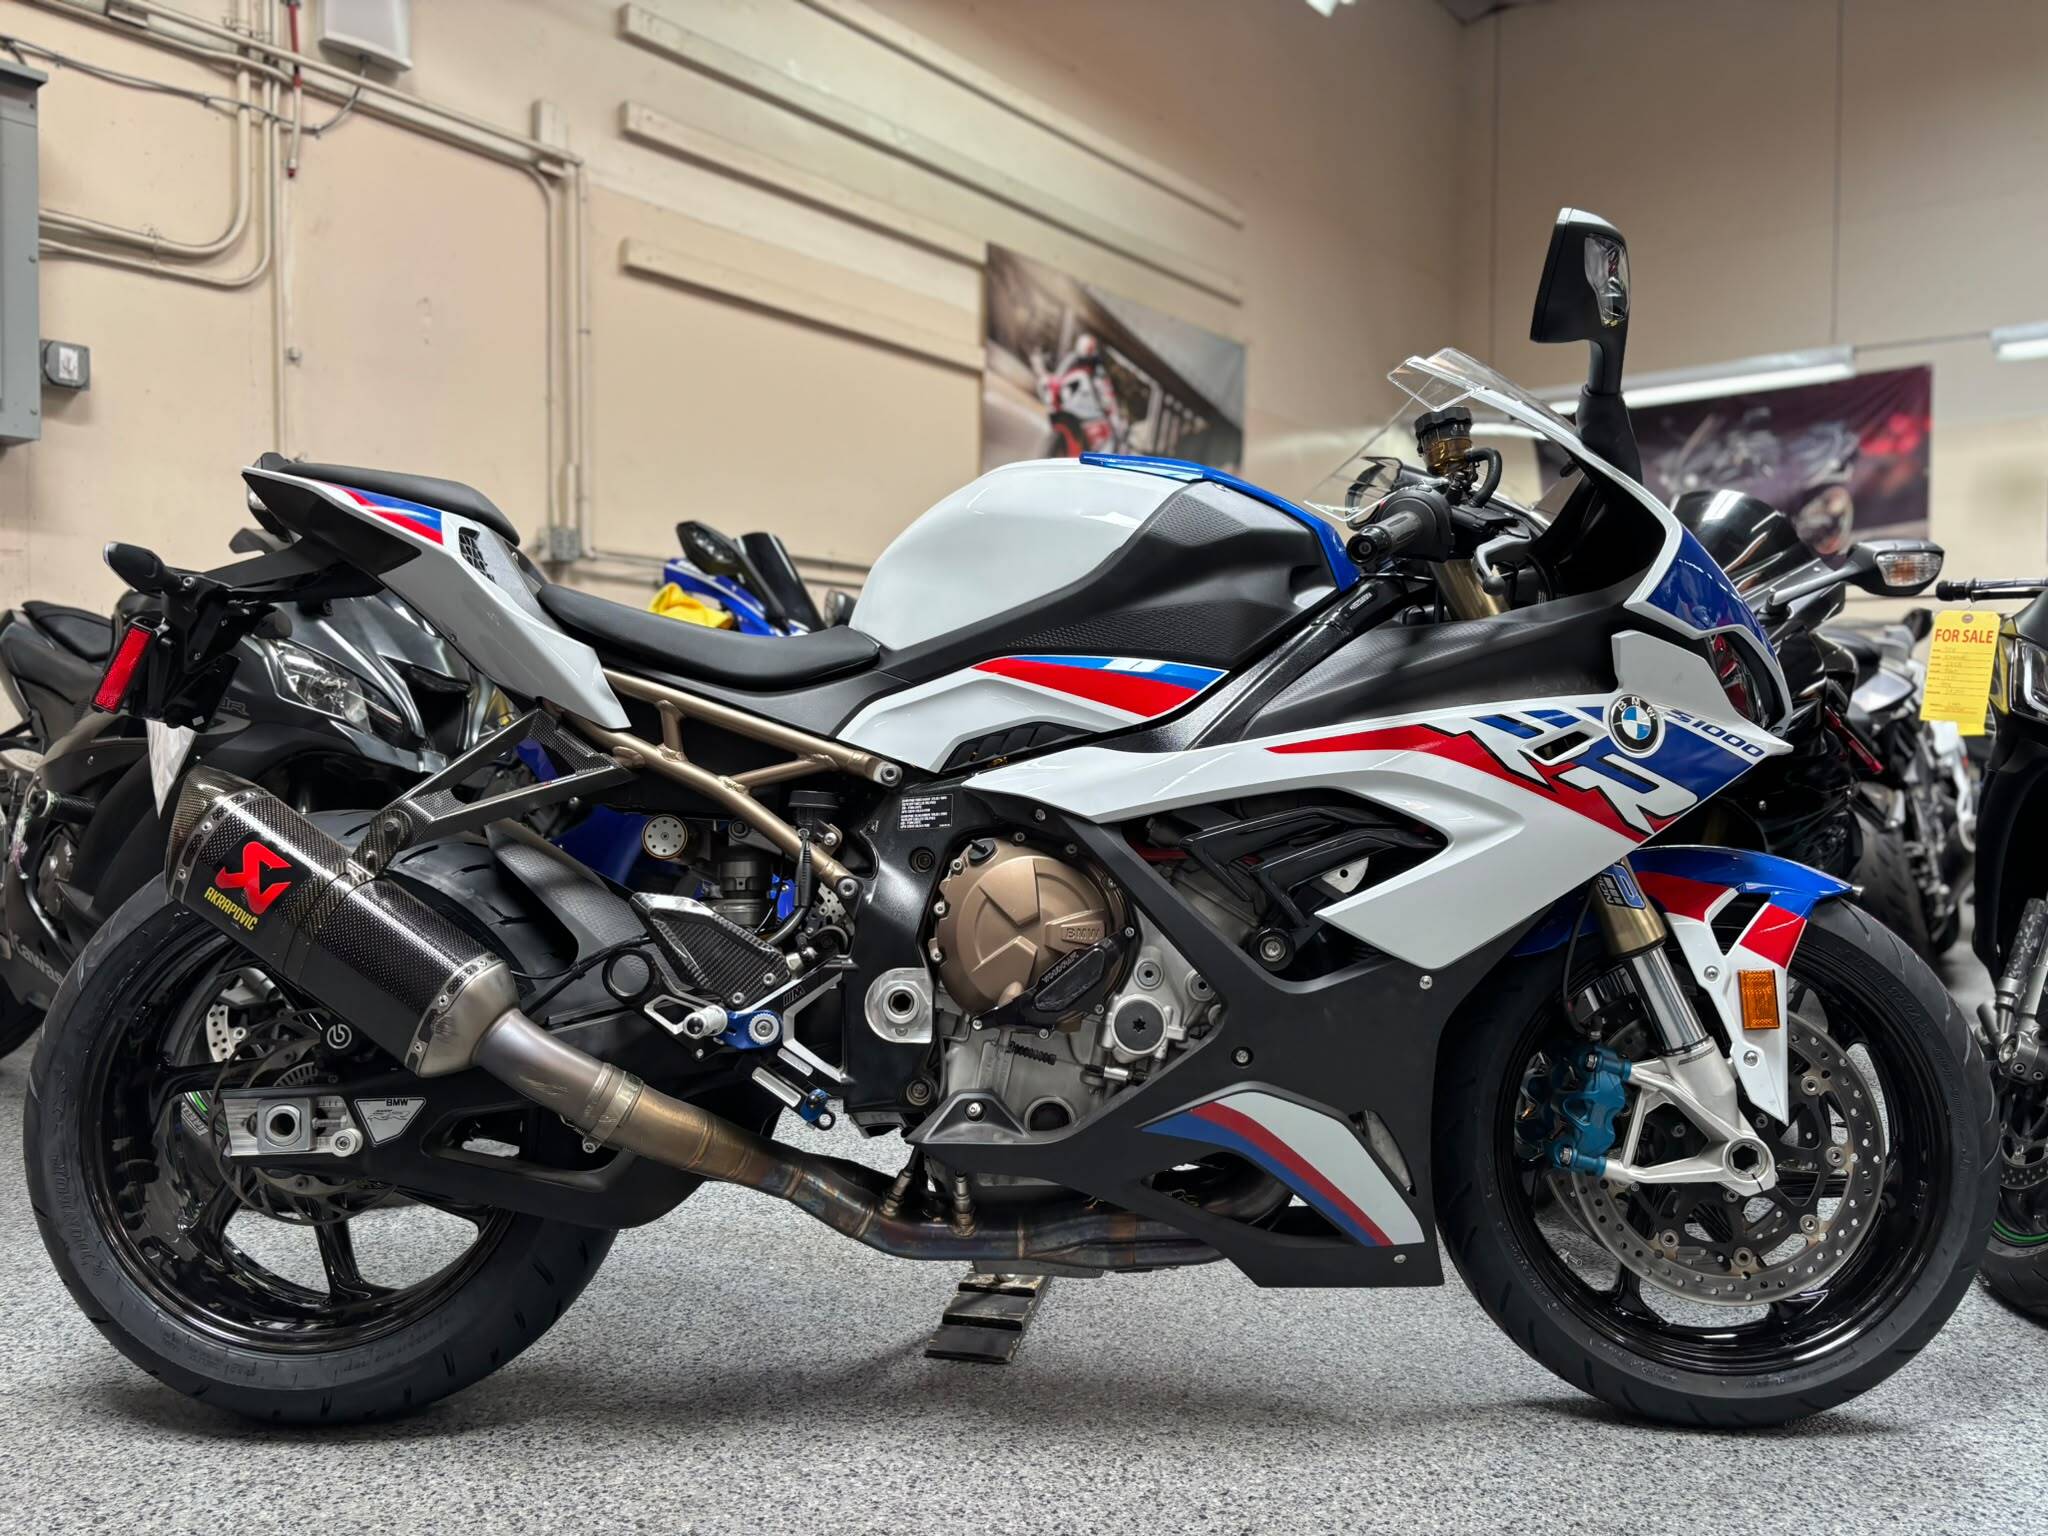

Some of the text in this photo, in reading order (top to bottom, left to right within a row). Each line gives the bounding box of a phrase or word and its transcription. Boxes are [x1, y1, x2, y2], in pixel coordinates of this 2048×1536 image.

[1935, 628, 1994, 644] FOR SALE
[1616, 695, 1657, 720] BMW
[1665, 708, 1766, 758] S1000
[1065, 926, 1102, 941] BMW
[385, 1098, 409, 1107] BMW
